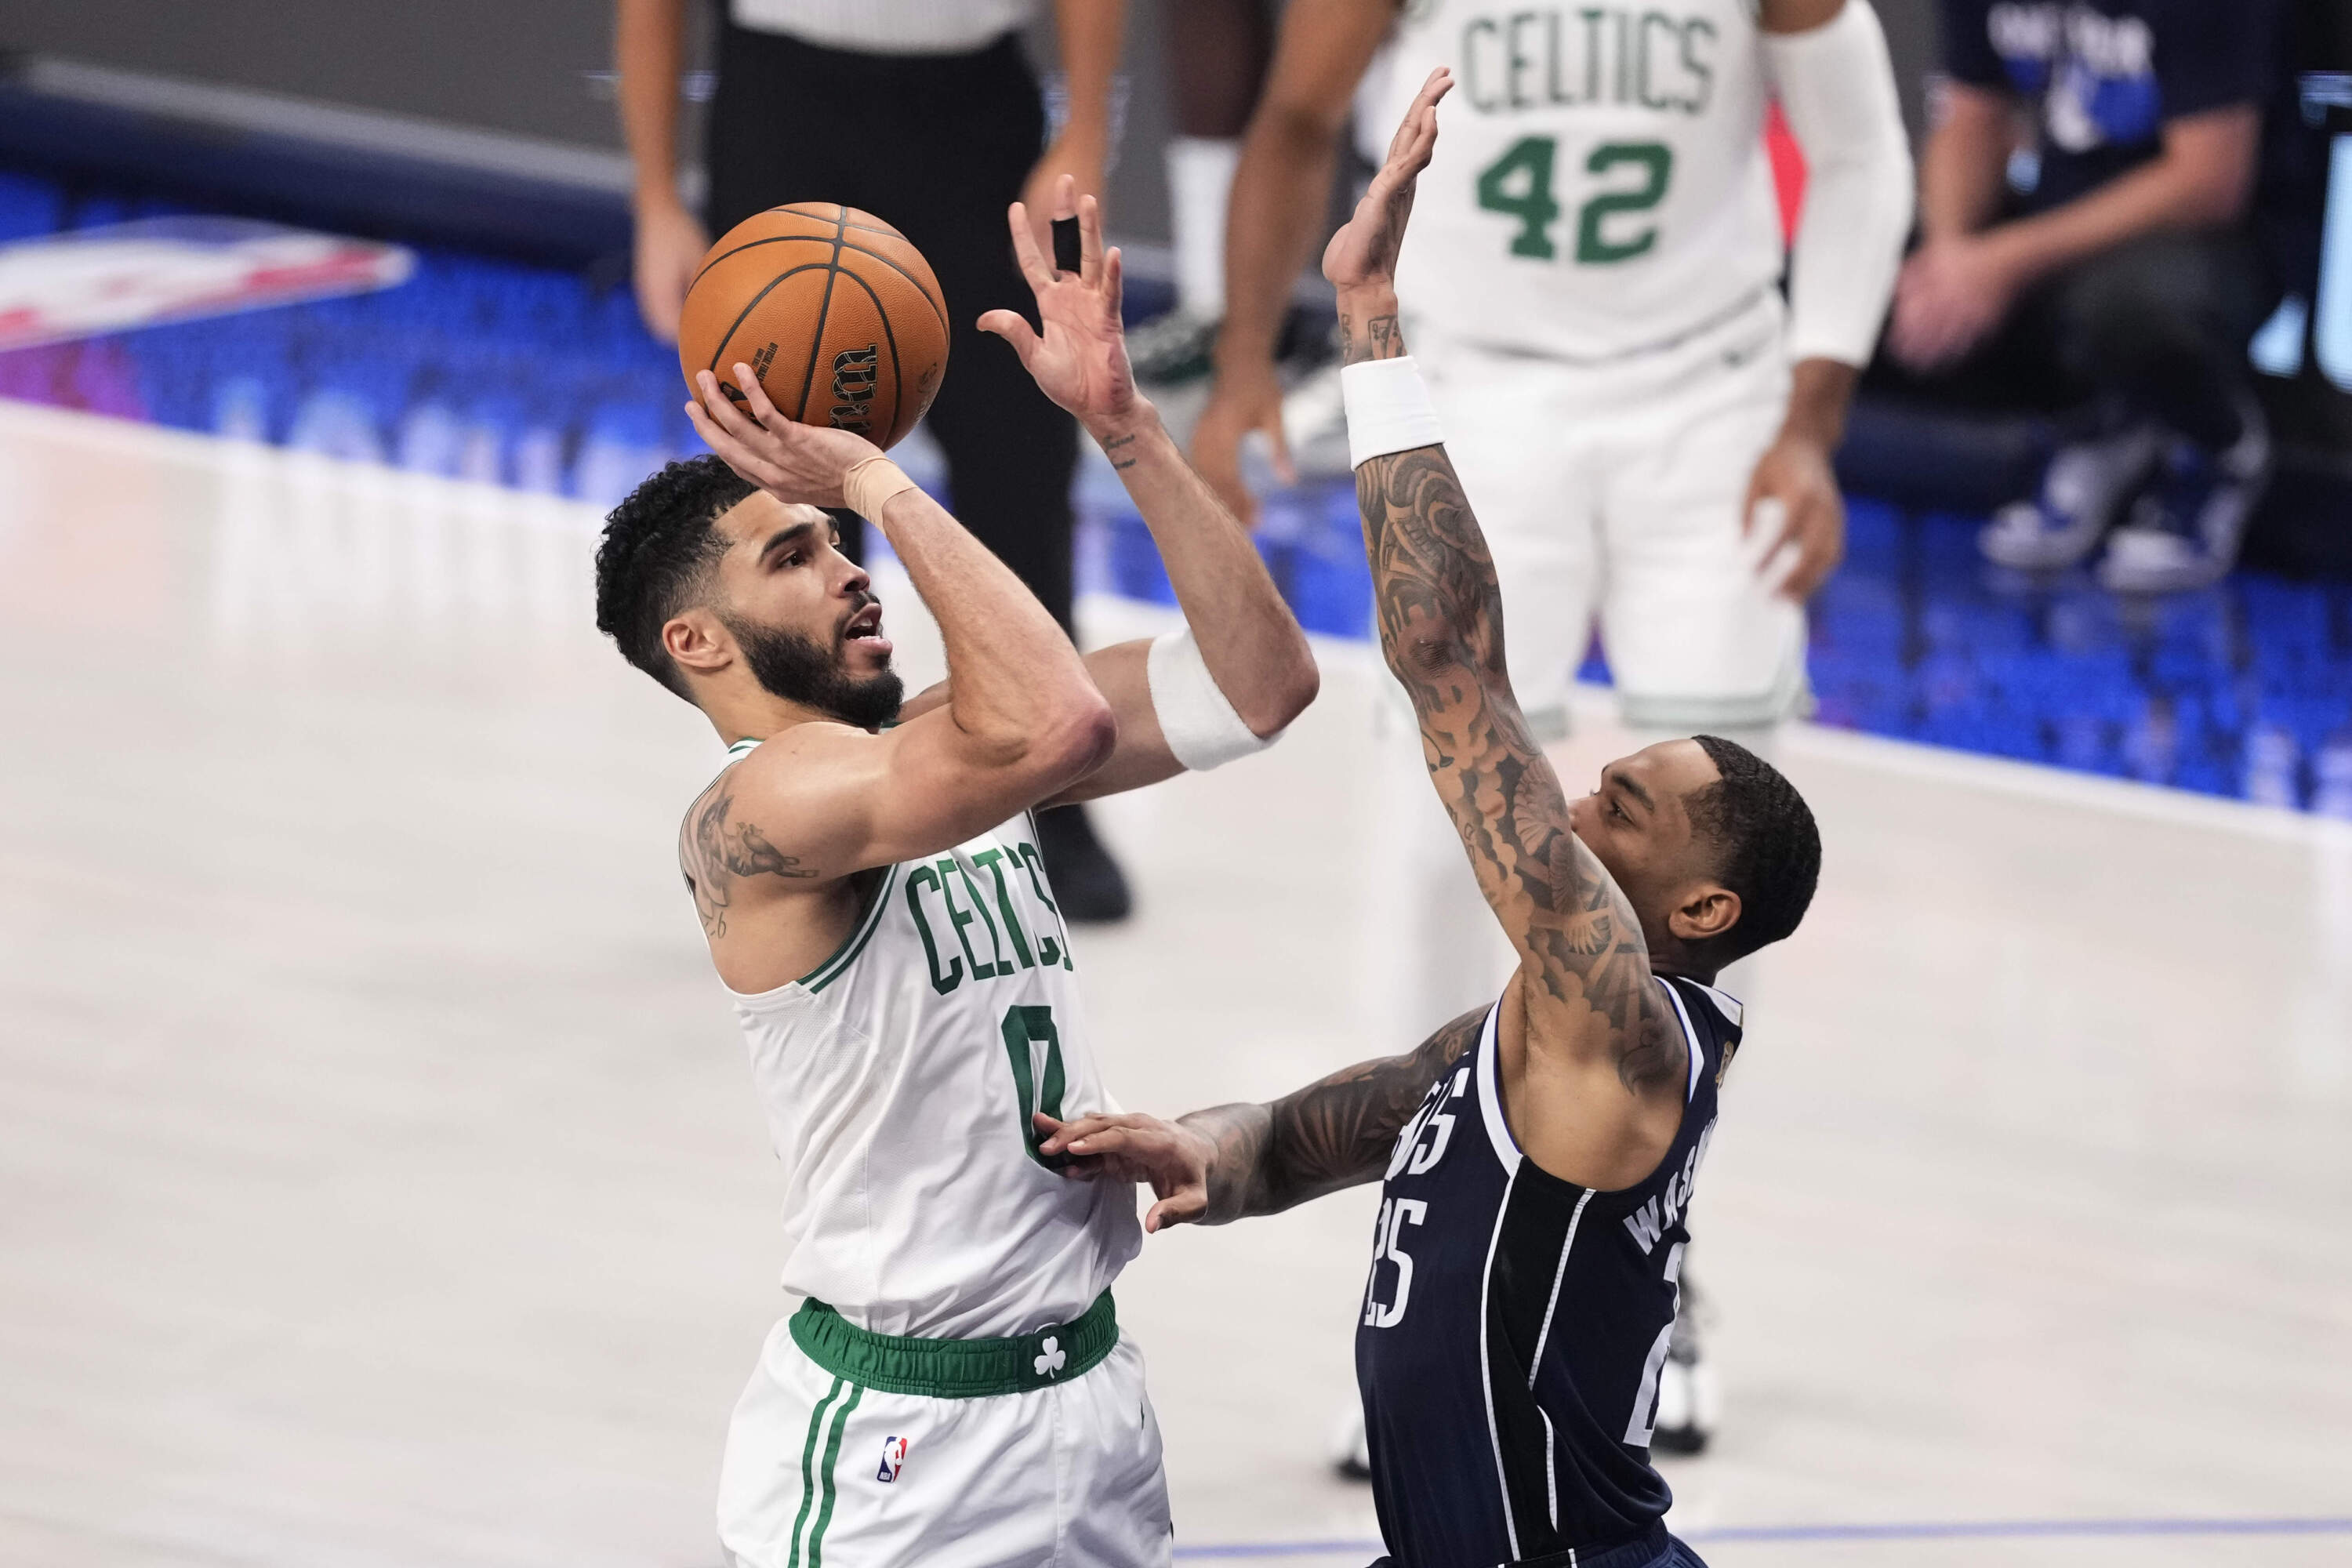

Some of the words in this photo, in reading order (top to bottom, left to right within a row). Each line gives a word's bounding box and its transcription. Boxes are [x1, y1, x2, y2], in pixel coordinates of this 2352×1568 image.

[1459, 8, 1718, 114] CELTICS
[1476, 133, 1673, 263] 42
[1001, 1005, 1067, 1178] 0
